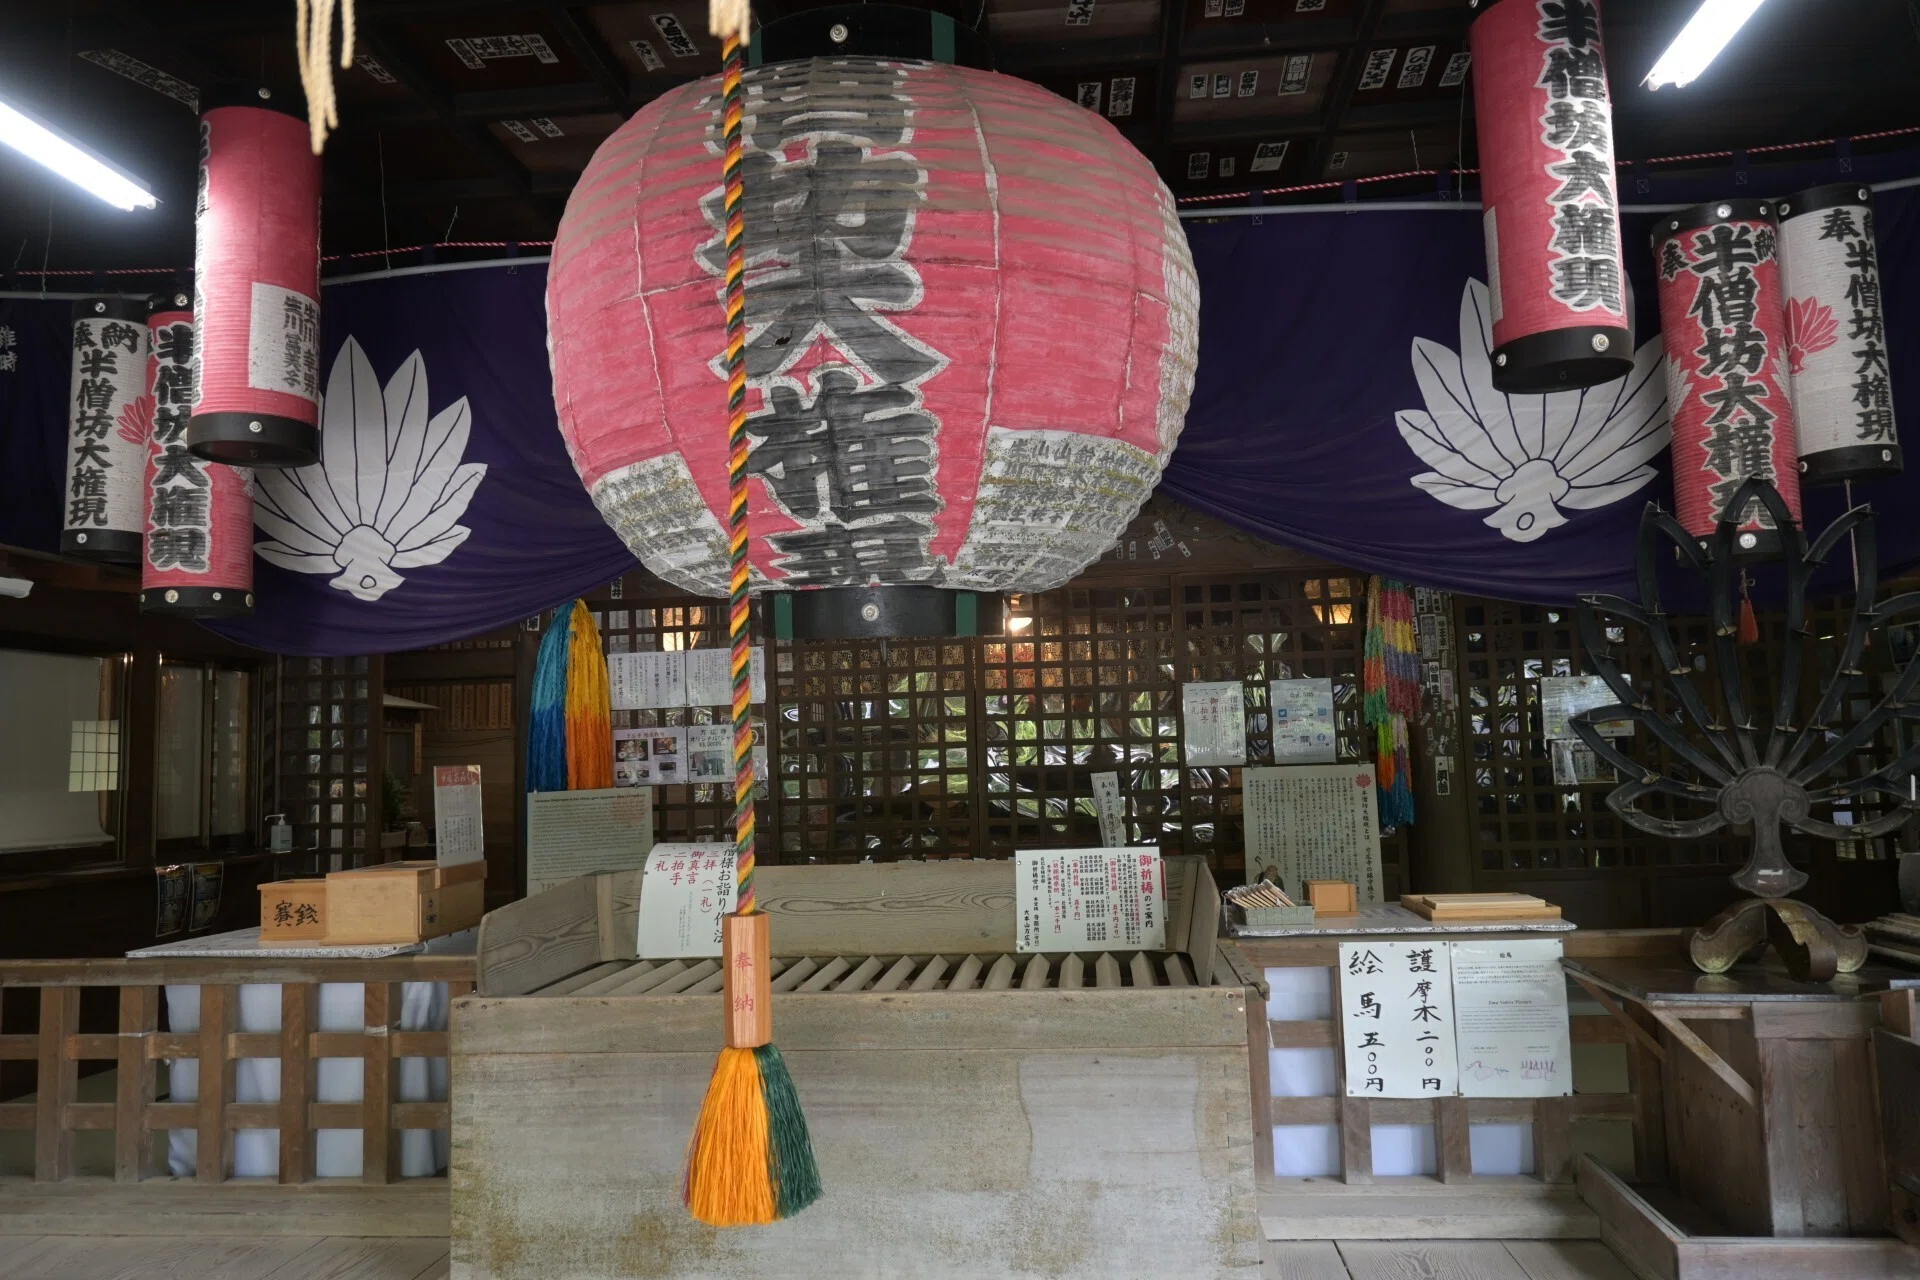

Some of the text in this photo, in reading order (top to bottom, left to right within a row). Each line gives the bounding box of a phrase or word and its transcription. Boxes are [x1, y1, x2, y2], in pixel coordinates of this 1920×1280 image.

[75, 321, 140, 354] 奉納
[1845, 240, 1896, 442] 半僧坊大権現
[68, 348, 118, 528] 半僧坊大権現
[1139, 854, 1154, 929] 御祈祷のご案内
[1023, 909, 1031, 948] 大本山方広寺
[734, 951, 754, 1012] 奉納
